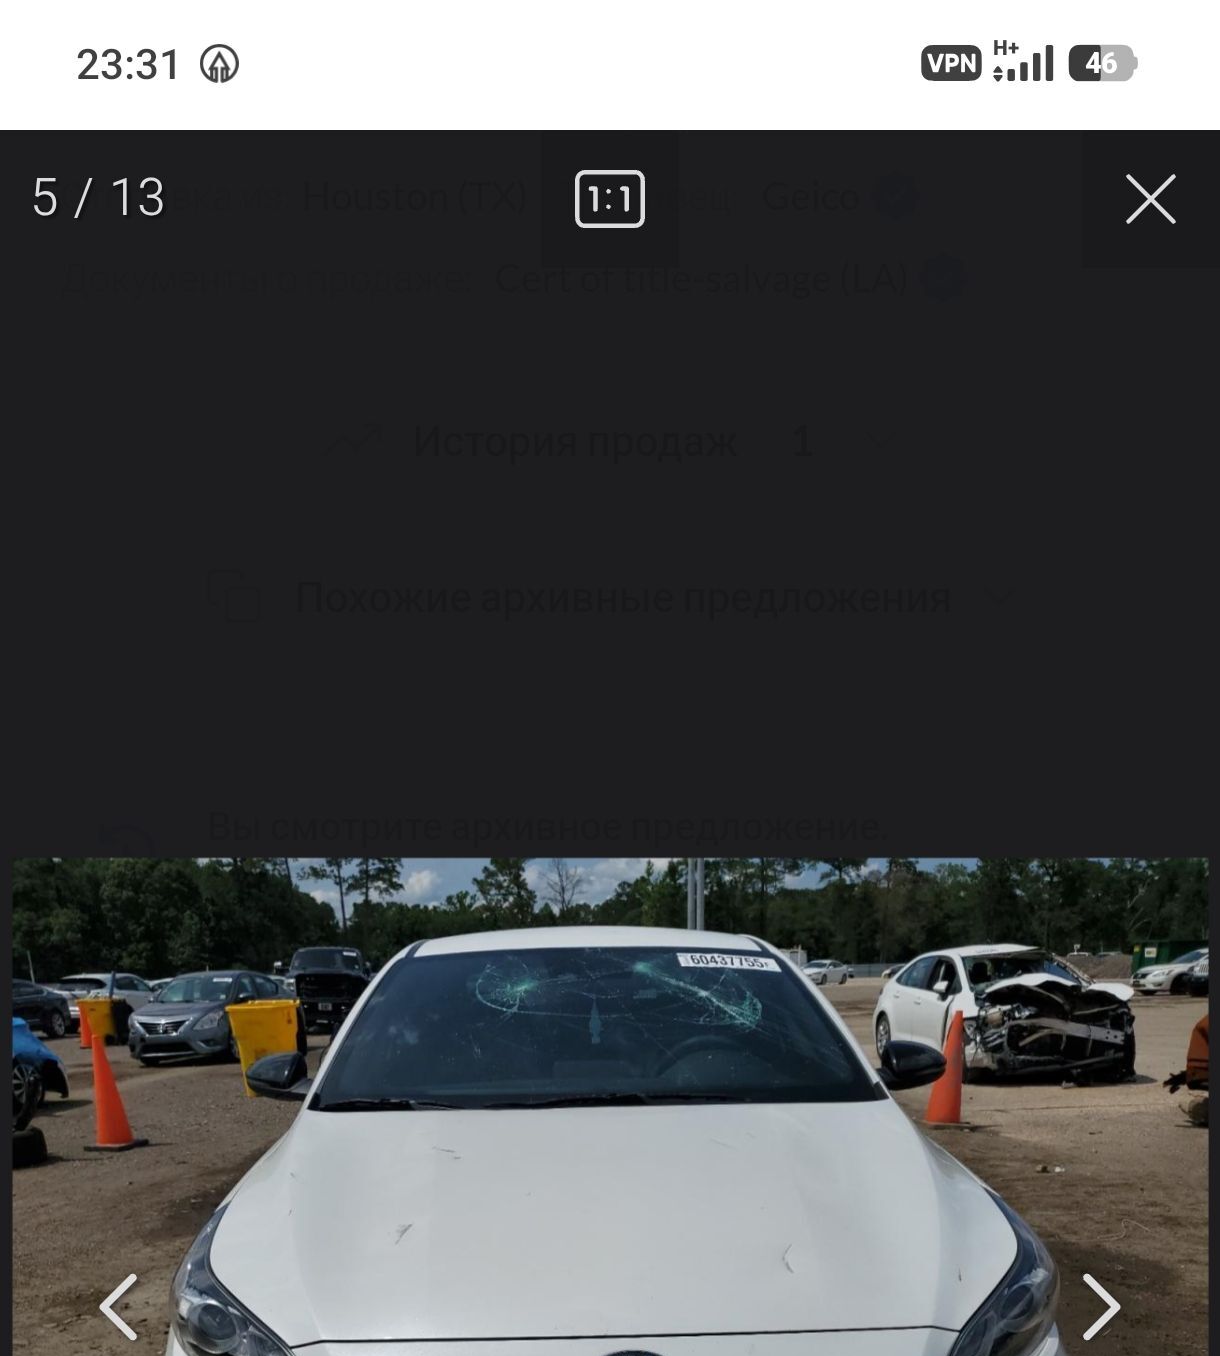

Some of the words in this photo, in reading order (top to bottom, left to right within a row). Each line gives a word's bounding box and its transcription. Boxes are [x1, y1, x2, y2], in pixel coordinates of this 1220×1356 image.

[927, 53, 977, 73] VPN
[993, 39, 1019, 56] H+
[1085, 51, 1118, 74] 46
[77, 48, 177, 81] 23:31
[33, 177, 58, 217] 5
[73, 177, 94, 220] /
[112, 177, 165, 217] 13
[303, 181, 449, 211] Houston
[458, 179, 526, 215] (TX)
[587, 184, 631, 214] 1:1
[762, 180, 860, 212] Geico
[495, 263, 575, 294] Cert
[580, 263, 615, 294] of
[624, 263, 831, 299] title-salvage
[841, 262, 908, 297] (LA)
[413, 425, 578, 465] История
[588, 431, 738, 465] продаж
[793, 425, 817, 457] 1
[296, 581, 472, 618] Похожие
[481, 587, 674, 622] архивные
[684, 584, 951, 622] предложения
[208, 811, 260, 841] Вы
[271, 815, 442, 849] смотрите
[451, 815, 622, 849] архивное
[631, 815, 889, 849] предложение.
[690, 954, 764, 968] 60437755
